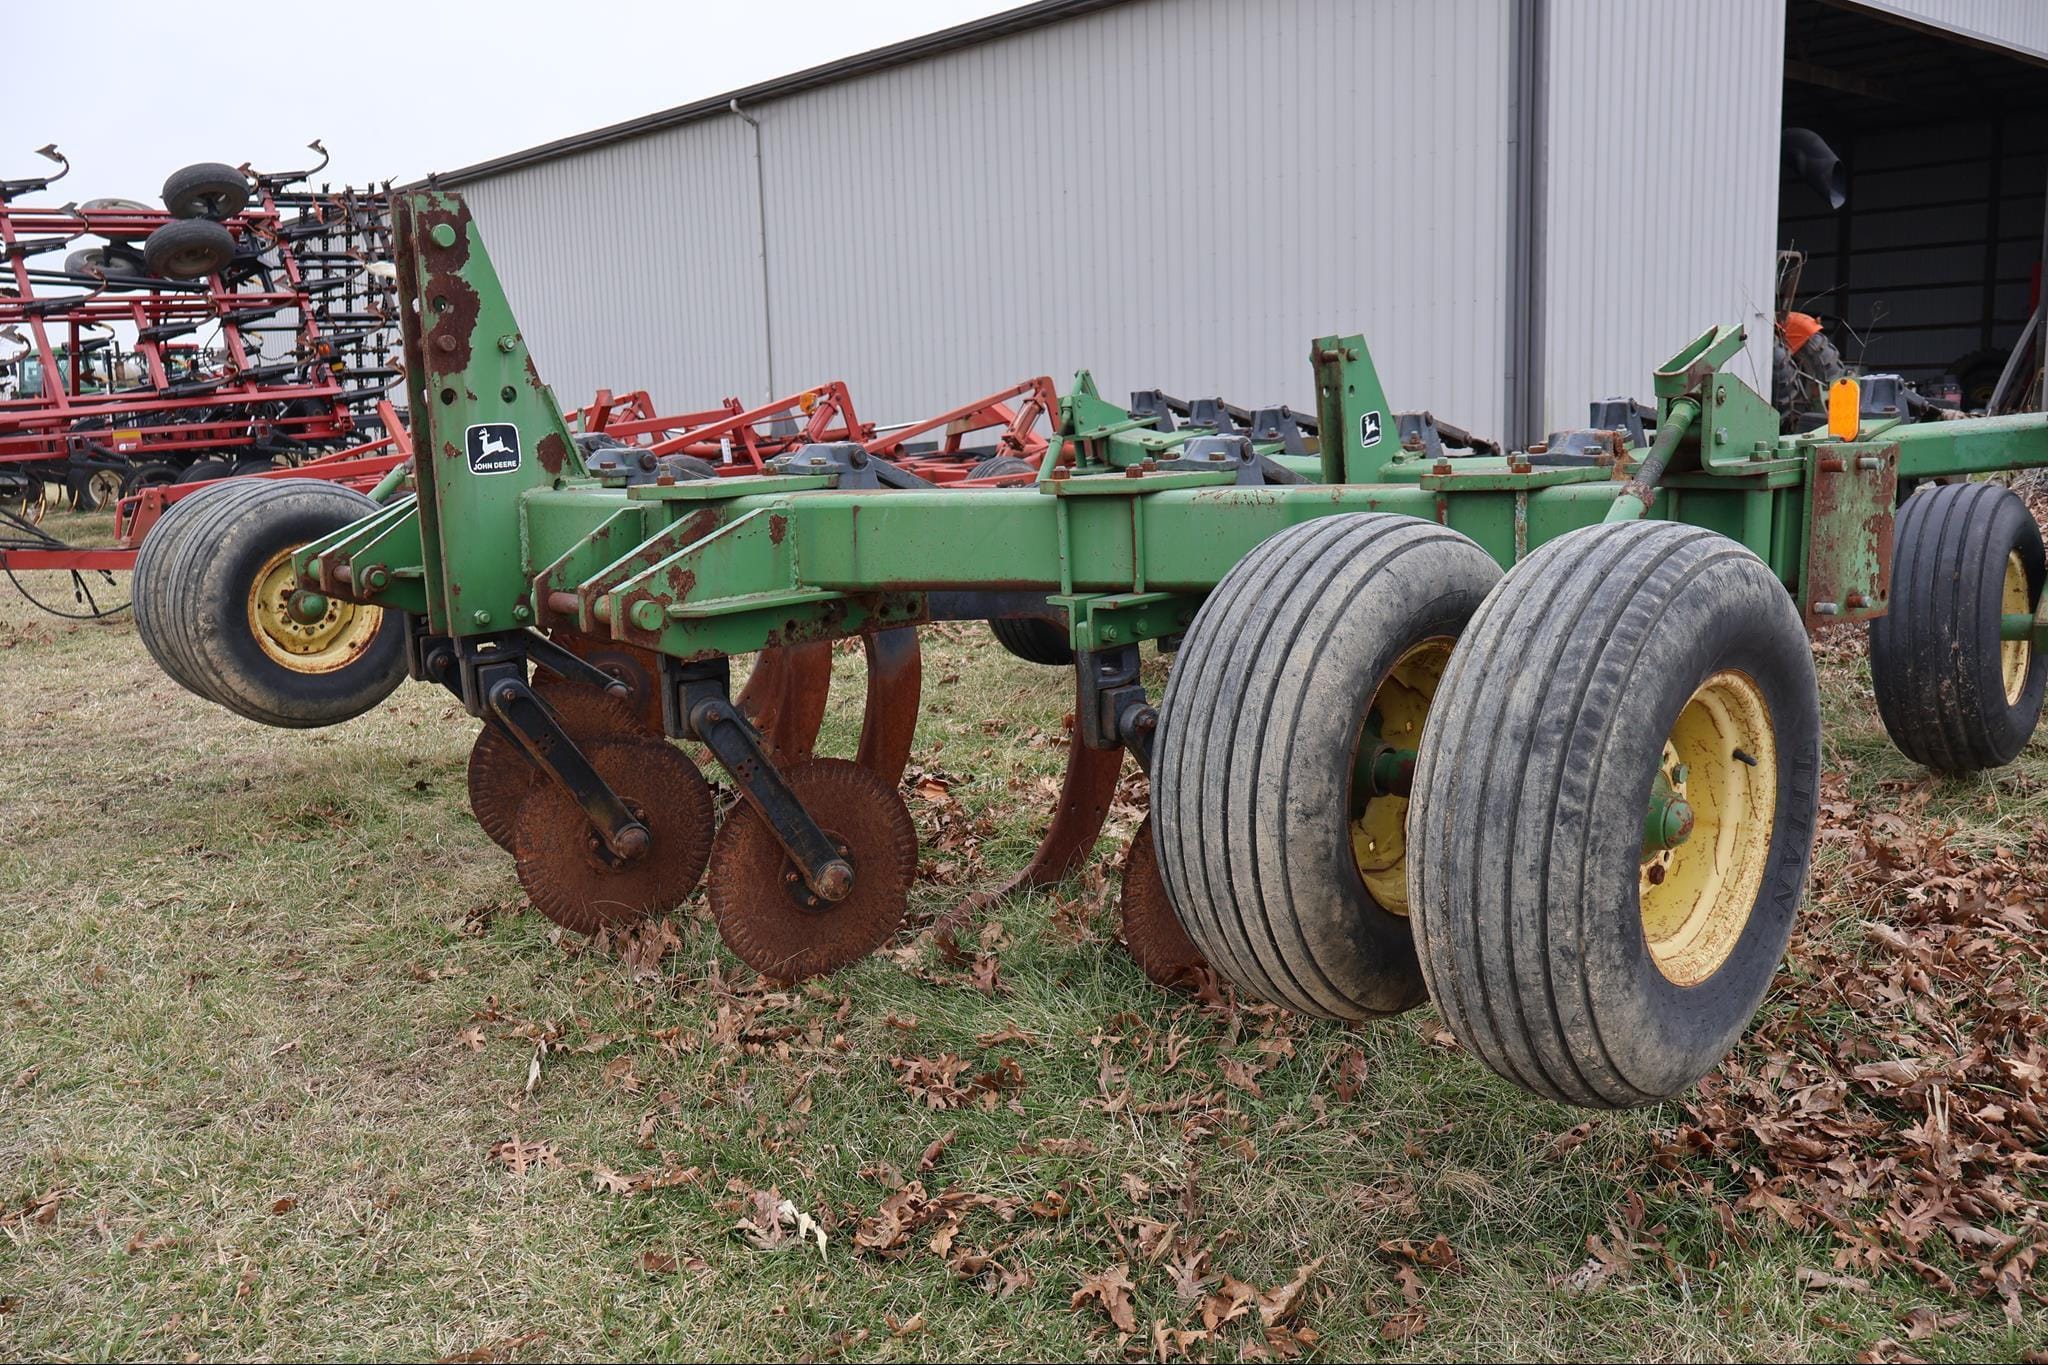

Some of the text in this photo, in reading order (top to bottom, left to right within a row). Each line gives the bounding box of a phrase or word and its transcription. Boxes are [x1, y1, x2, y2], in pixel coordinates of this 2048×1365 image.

[473, 460, 517, 471] JOHN DEERE
[1774, 751, 1815, 913] TITAN
